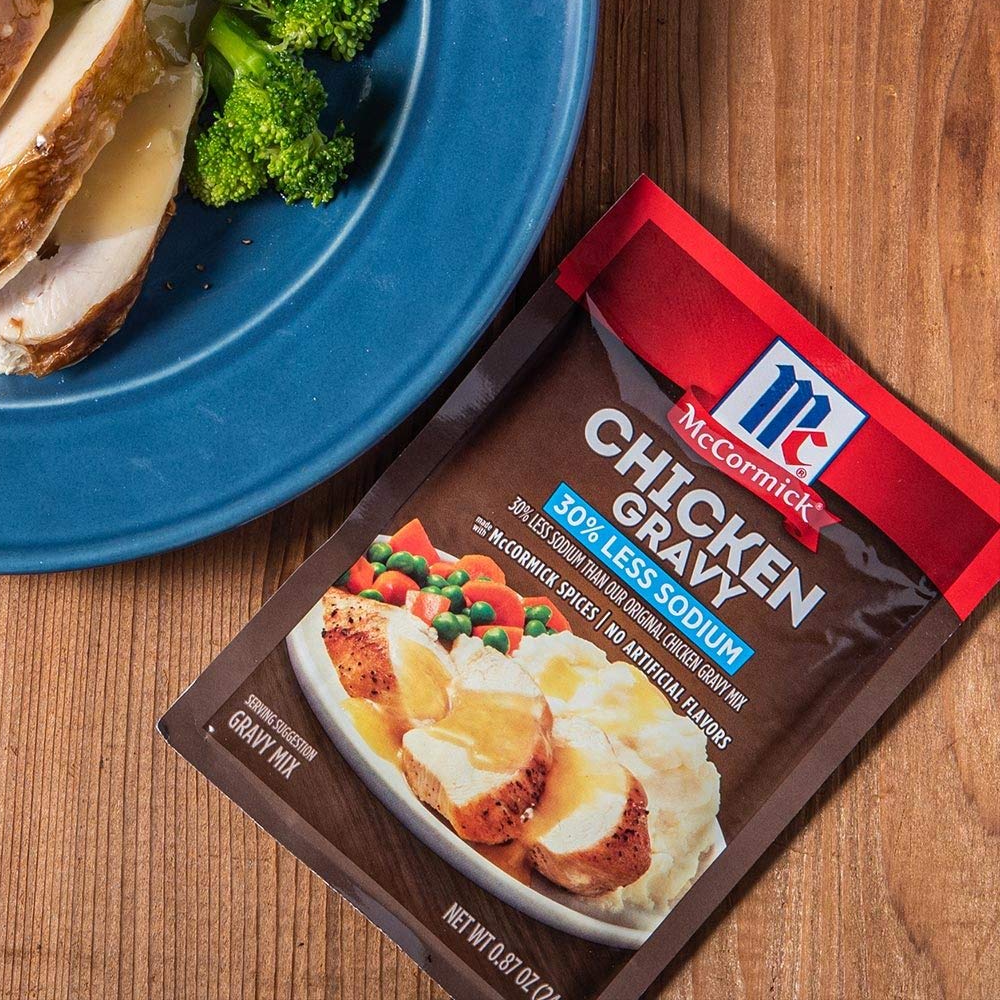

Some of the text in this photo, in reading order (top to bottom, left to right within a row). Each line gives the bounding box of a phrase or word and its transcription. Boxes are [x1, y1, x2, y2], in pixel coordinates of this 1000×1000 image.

[472, 523, 487, 537] with
[475, 516, 493, 531] made
[584, 408, 826, 628] CHICKEN
[612, 491, 747, 609] GRAVY
[507, 496, 748, 712] 30% LESS SODIUM THAN OUR ORIGINAL CHICKEN GRAVY MIX
[553, 493, 744, 665] 30% LESS SODIUM
[556, 581, 600, 621] SPICES
[244, 693, 318, 762] SERVING SUGGESTION
[604, 622, 732, 749] NO ARTIFICIAL FLAVORS
[228, 710, 301, 779] GRAVY MIX
[442, 902, 476, 934] NET
[467, 922, 497, 952] WT
[487, 942, 523, 975] 0.87
[515, 967, 541, 993] OZ
